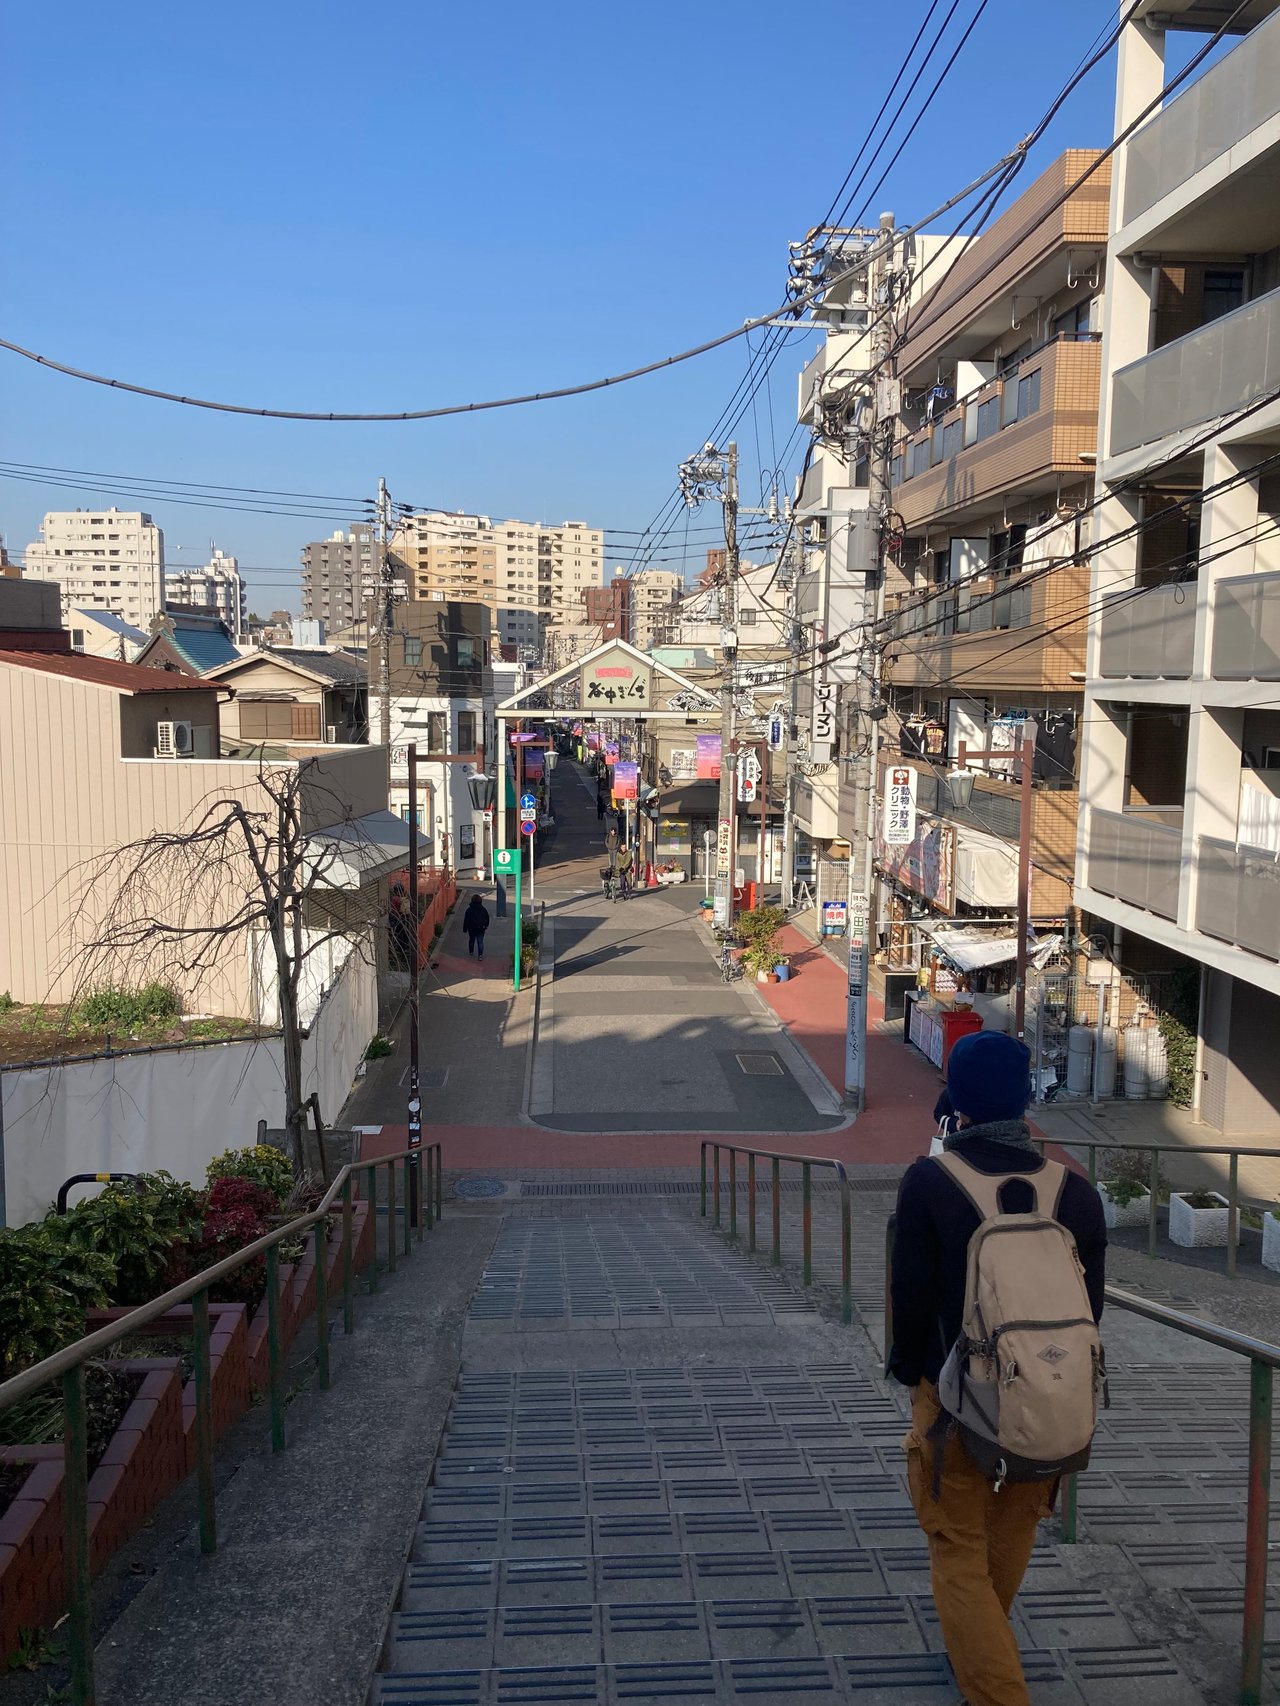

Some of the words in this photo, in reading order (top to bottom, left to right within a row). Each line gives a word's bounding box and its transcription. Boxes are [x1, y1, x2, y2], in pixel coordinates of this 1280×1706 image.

[588, 675, 646, 704] 谷中ぎんざ
[890, 786, 899, 828] クリニック
[899, 786, 910, 829] 動物・野澤
[826, 911, 844, 920] 焼肉
